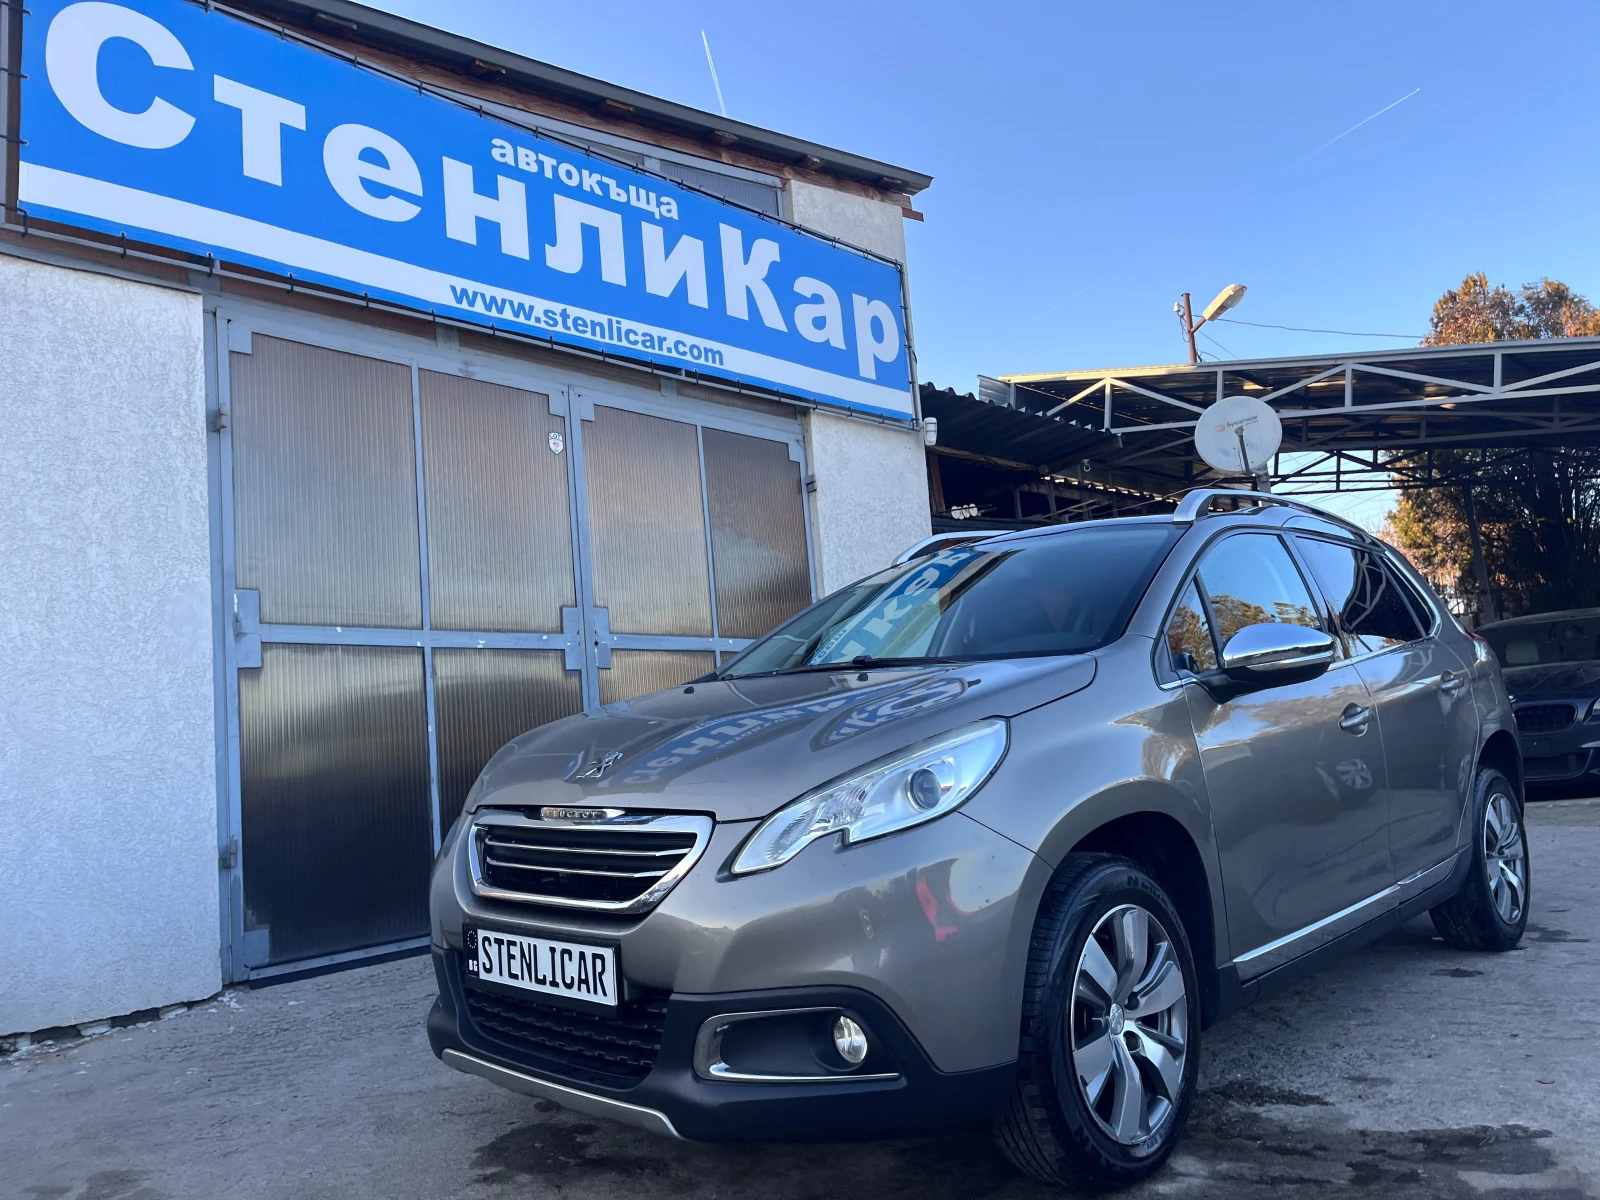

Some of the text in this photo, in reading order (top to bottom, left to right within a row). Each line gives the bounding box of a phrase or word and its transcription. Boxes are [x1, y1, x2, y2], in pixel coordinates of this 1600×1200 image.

[46, 1, 899, 380] СтенлиКар
[491, 138, 679, 220] автокъща
[450, 284, 724, 366] www.stenlicar.com
[546, 808, 597, 819] PEUGEOT
[468, 959, 478, 972] BG
[481, 935, 608, 997] STENLICAR
